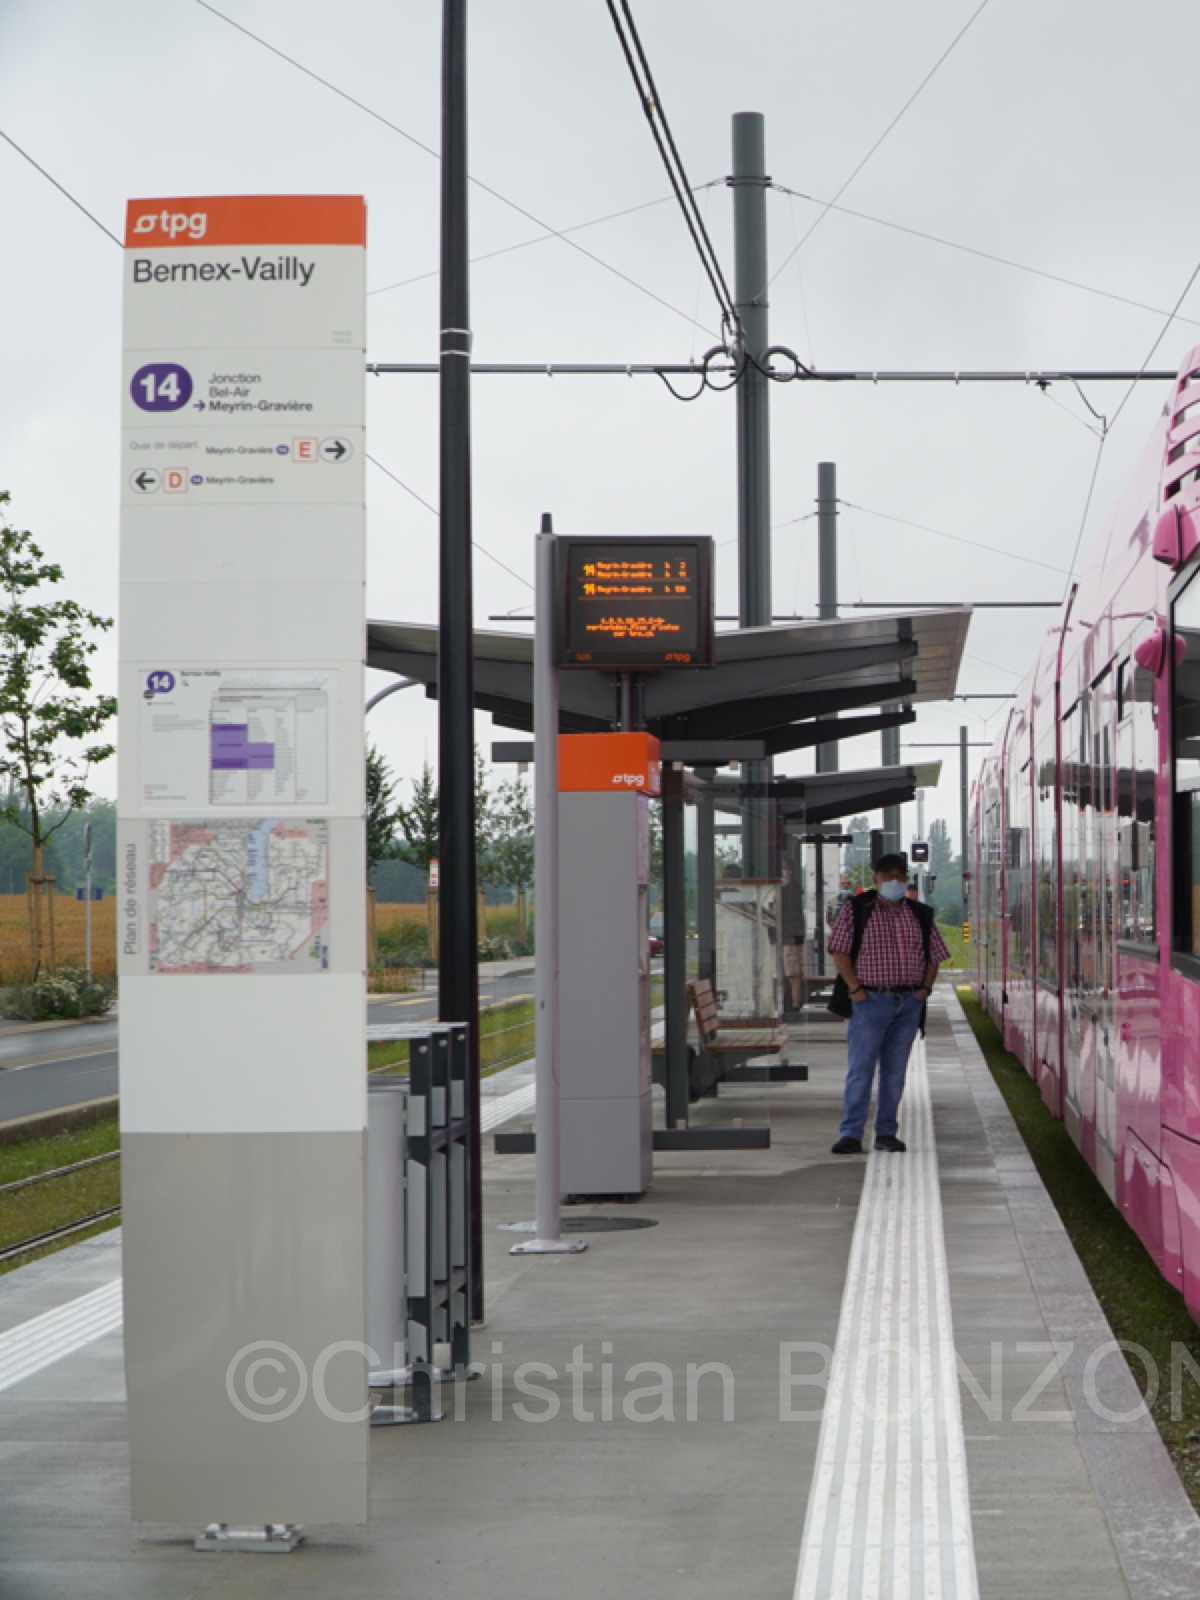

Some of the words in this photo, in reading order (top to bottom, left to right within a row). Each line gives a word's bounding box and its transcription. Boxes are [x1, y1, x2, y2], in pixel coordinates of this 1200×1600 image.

[160, 210, 207, 238] tpg
[133, 256, 315, 286] Bernex-Vailly
[140, 373, 181, 402] 14
[208, 373, 261, 384] Jonction
[208, 386, 250, 398] Bel-Air
[208, 400, 313, 414] Meyrin-Gravière
[299, 442, 311, 458] E
[169, 472, 182, 488] D
[151, 675, 171, 690] 14
[122, 843, 137, 895] réseau
[123, 898, 137, 919] de
[123, 921, 137, 955] Plan
